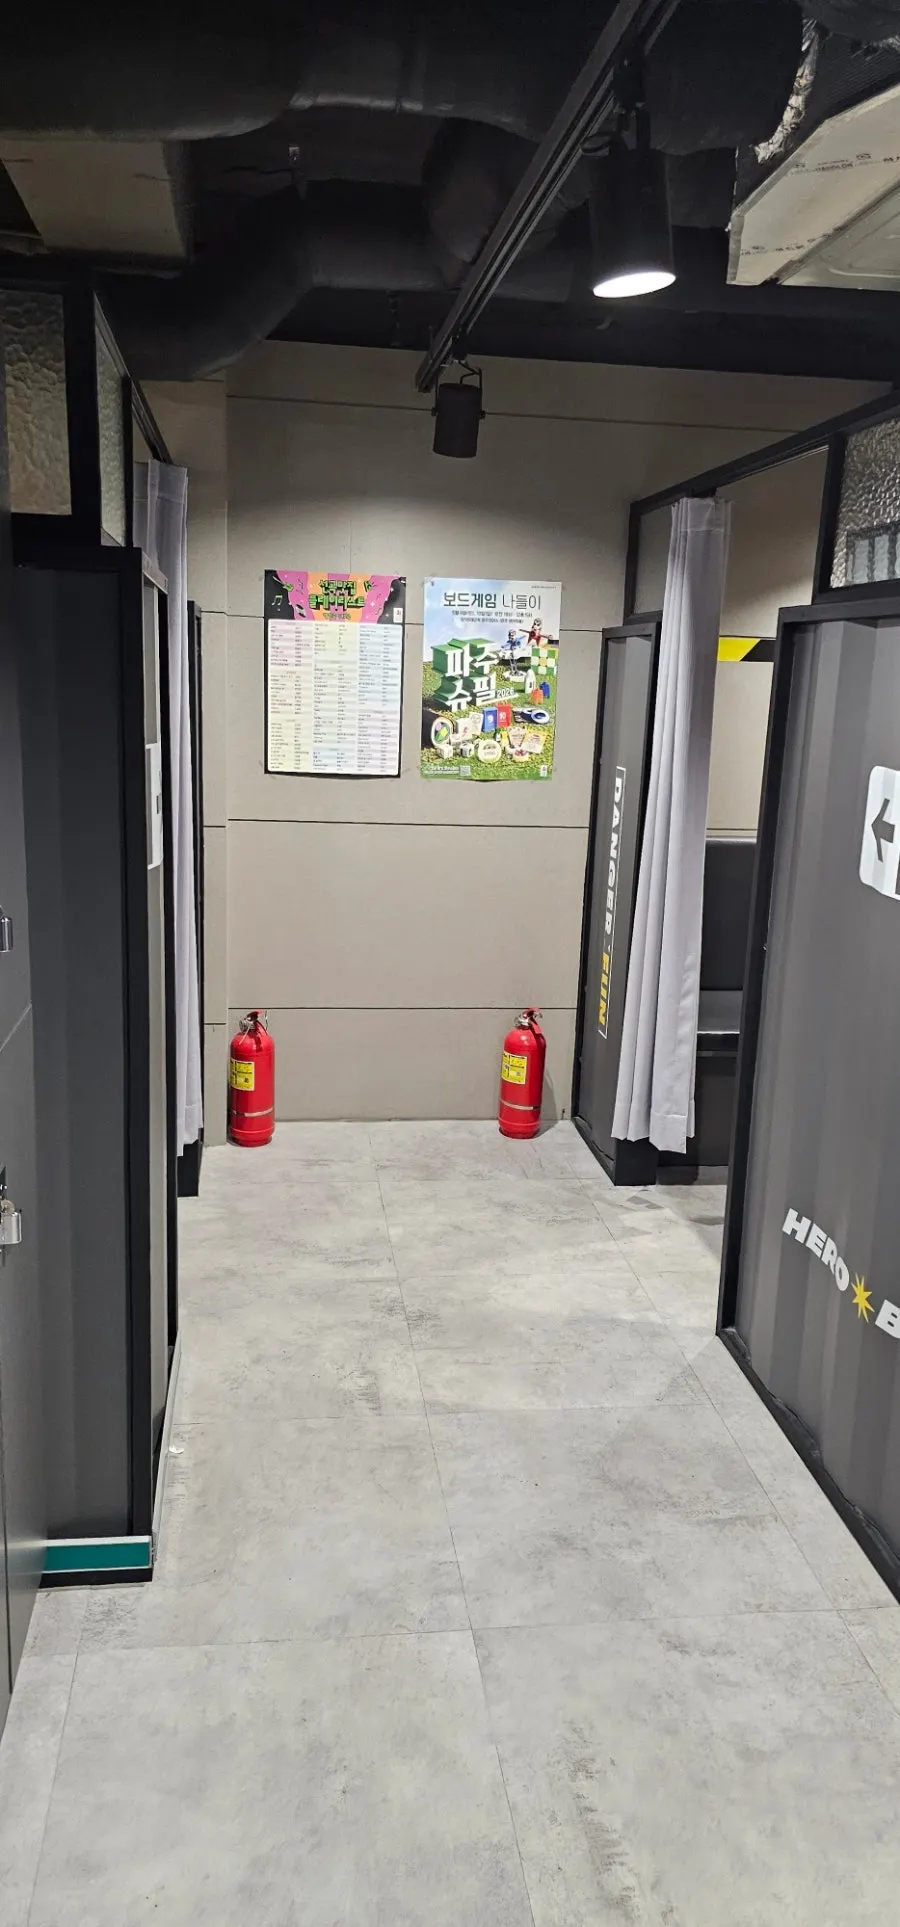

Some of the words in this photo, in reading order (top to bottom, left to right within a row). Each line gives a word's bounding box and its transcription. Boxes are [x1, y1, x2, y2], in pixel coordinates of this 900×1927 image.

[308, 594, 365, 611] 플레이리스트
[443, 592, 497, 609] 보드게임
[502, 594, 541, 610] 나들이
[444, 642, 500, 677] 파주
[445, 671, 497, 712] 슈필
[604, 777, 623, 936] DANGER
[599, 952, 610, 1026] FUN
[782, 1207, 850, 1292] HERO
